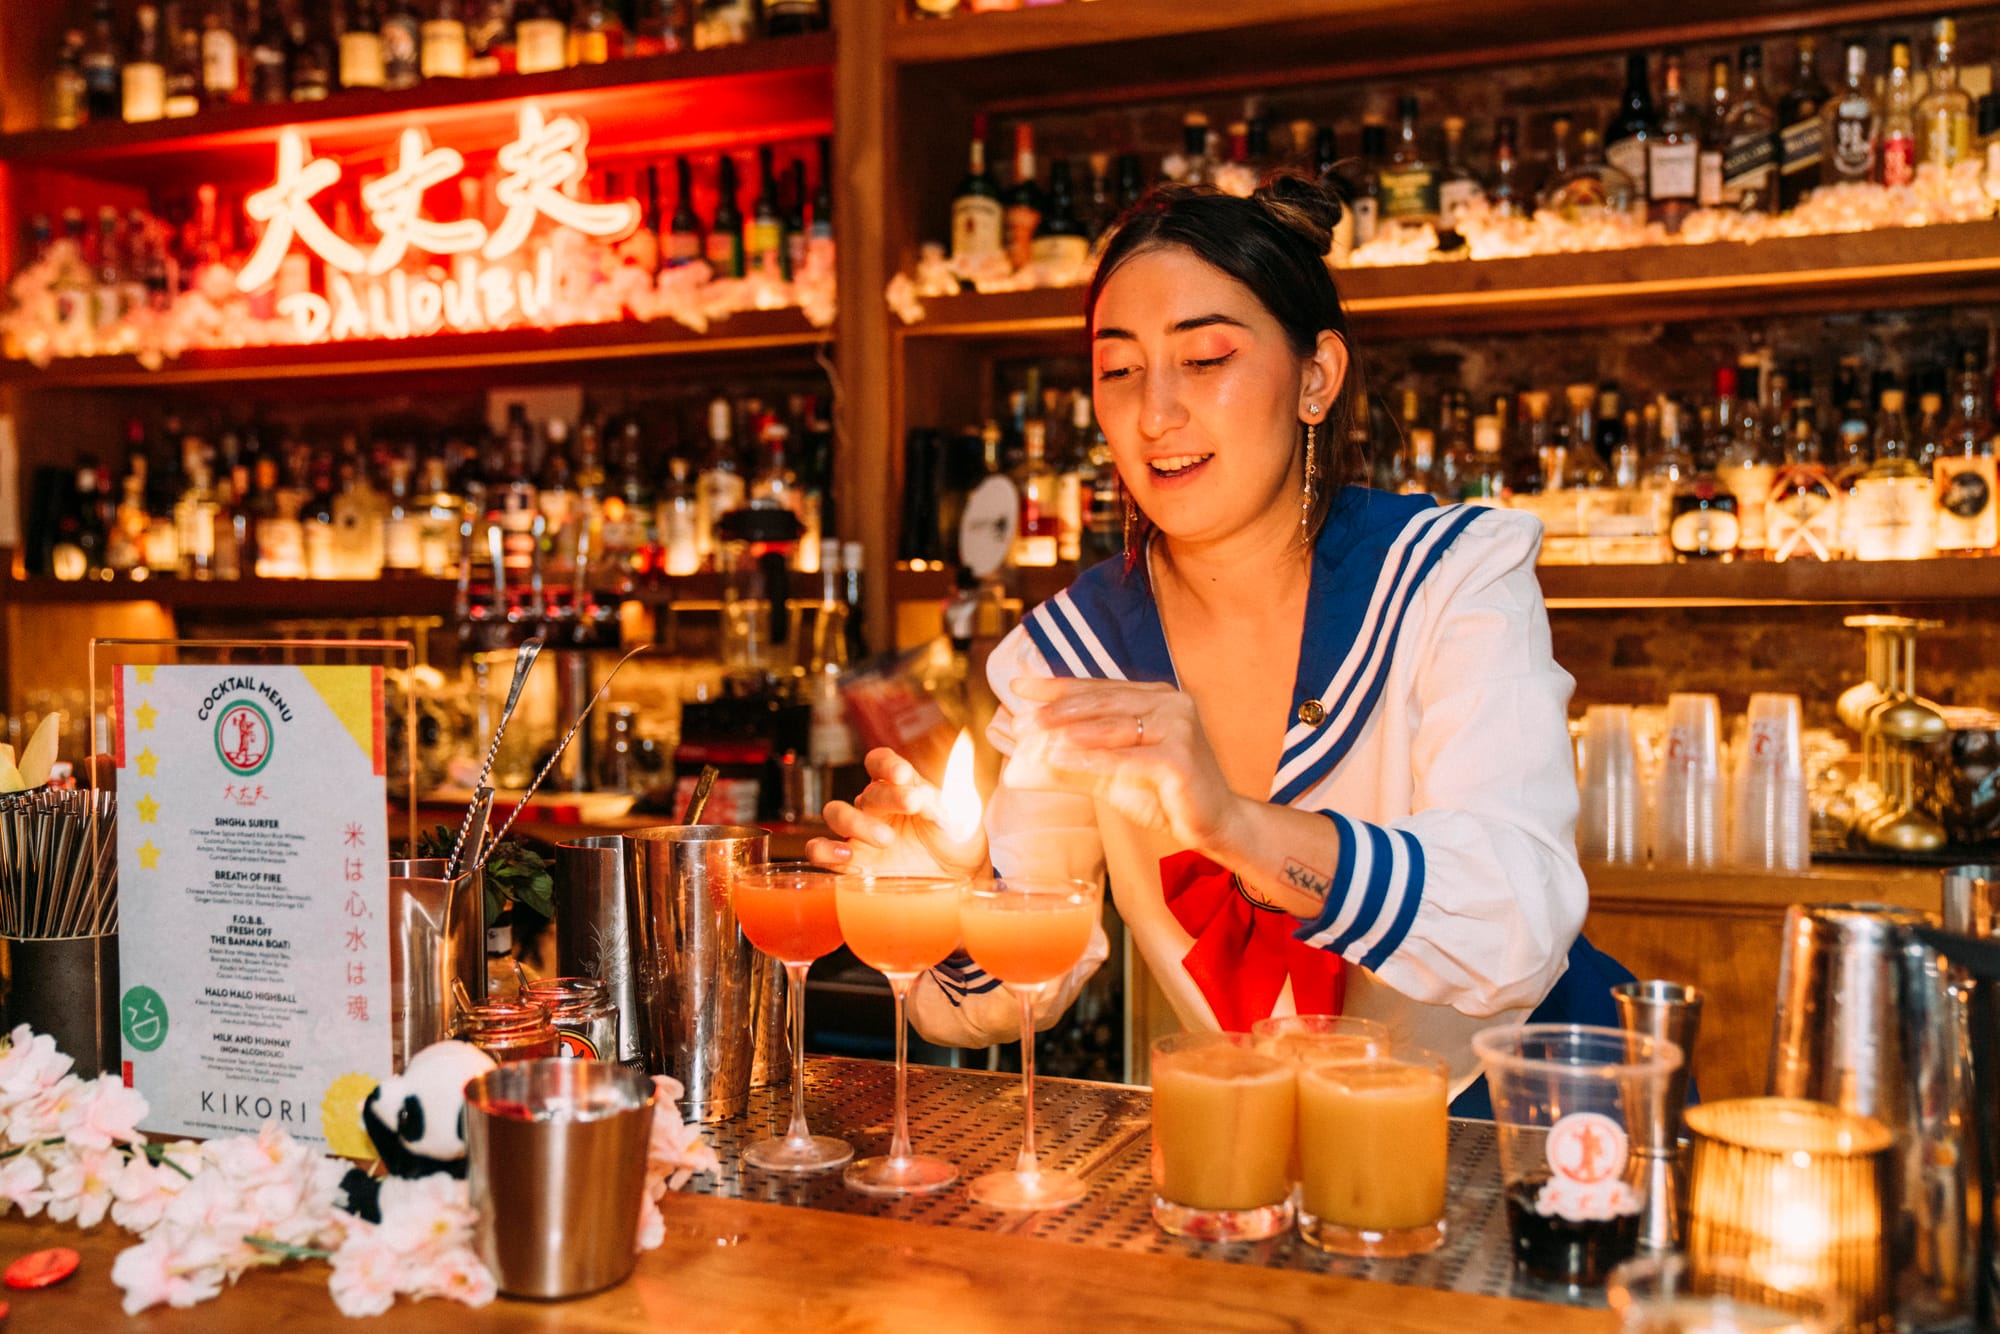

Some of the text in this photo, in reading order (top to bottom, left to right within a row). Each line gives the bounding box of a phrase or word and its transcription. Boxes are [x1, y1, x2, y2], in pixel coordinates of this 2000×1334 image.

[236, 103, 640, 292] 大丈夫
[198, 676, 293, 722] COCKTAIL MENU
[215, 817, 279, 829] SINGHA SURFER
[215, 870, 282, 883] BREATH OF FIRE
[233, 915, 265, 925] F.O.B.B.
[226, 925, 272, 936] (FRESH OFF
[211, 935, 290, 949] THE BANANA BOAT)
[205, 987, 296, 1003] HALO HALO HIGHBALL
[213, 1033, 291, 1048] MILK AND HUNNAY
[201, 1090, 306, 1123] KIKORI
